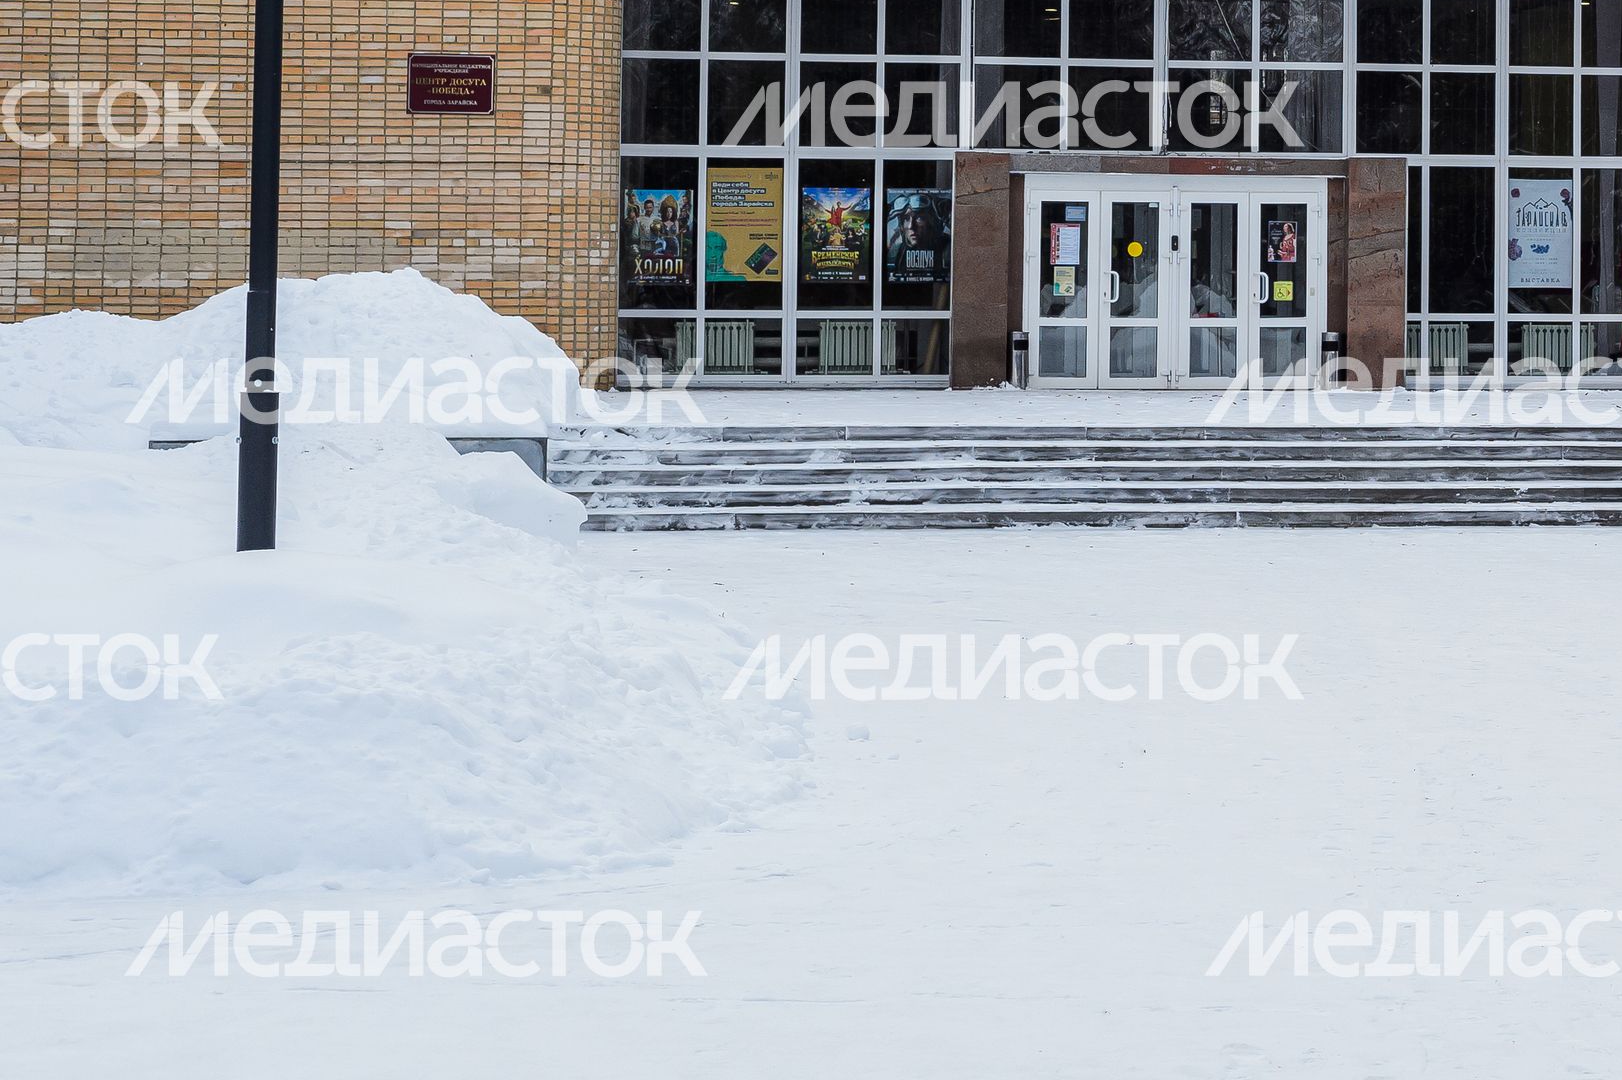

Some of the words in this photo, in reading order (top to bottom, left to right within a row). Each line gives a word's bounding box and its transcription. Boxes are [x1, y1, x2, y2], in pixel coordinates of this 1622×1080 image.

[415, 77, 447, 85] ЦЕНТР
[449, 78, 487, 87] ДОСУГА
[634, 258, 683, 275] ХОЛОП
[906, 250, 934, 269] ВОЗДУХ
